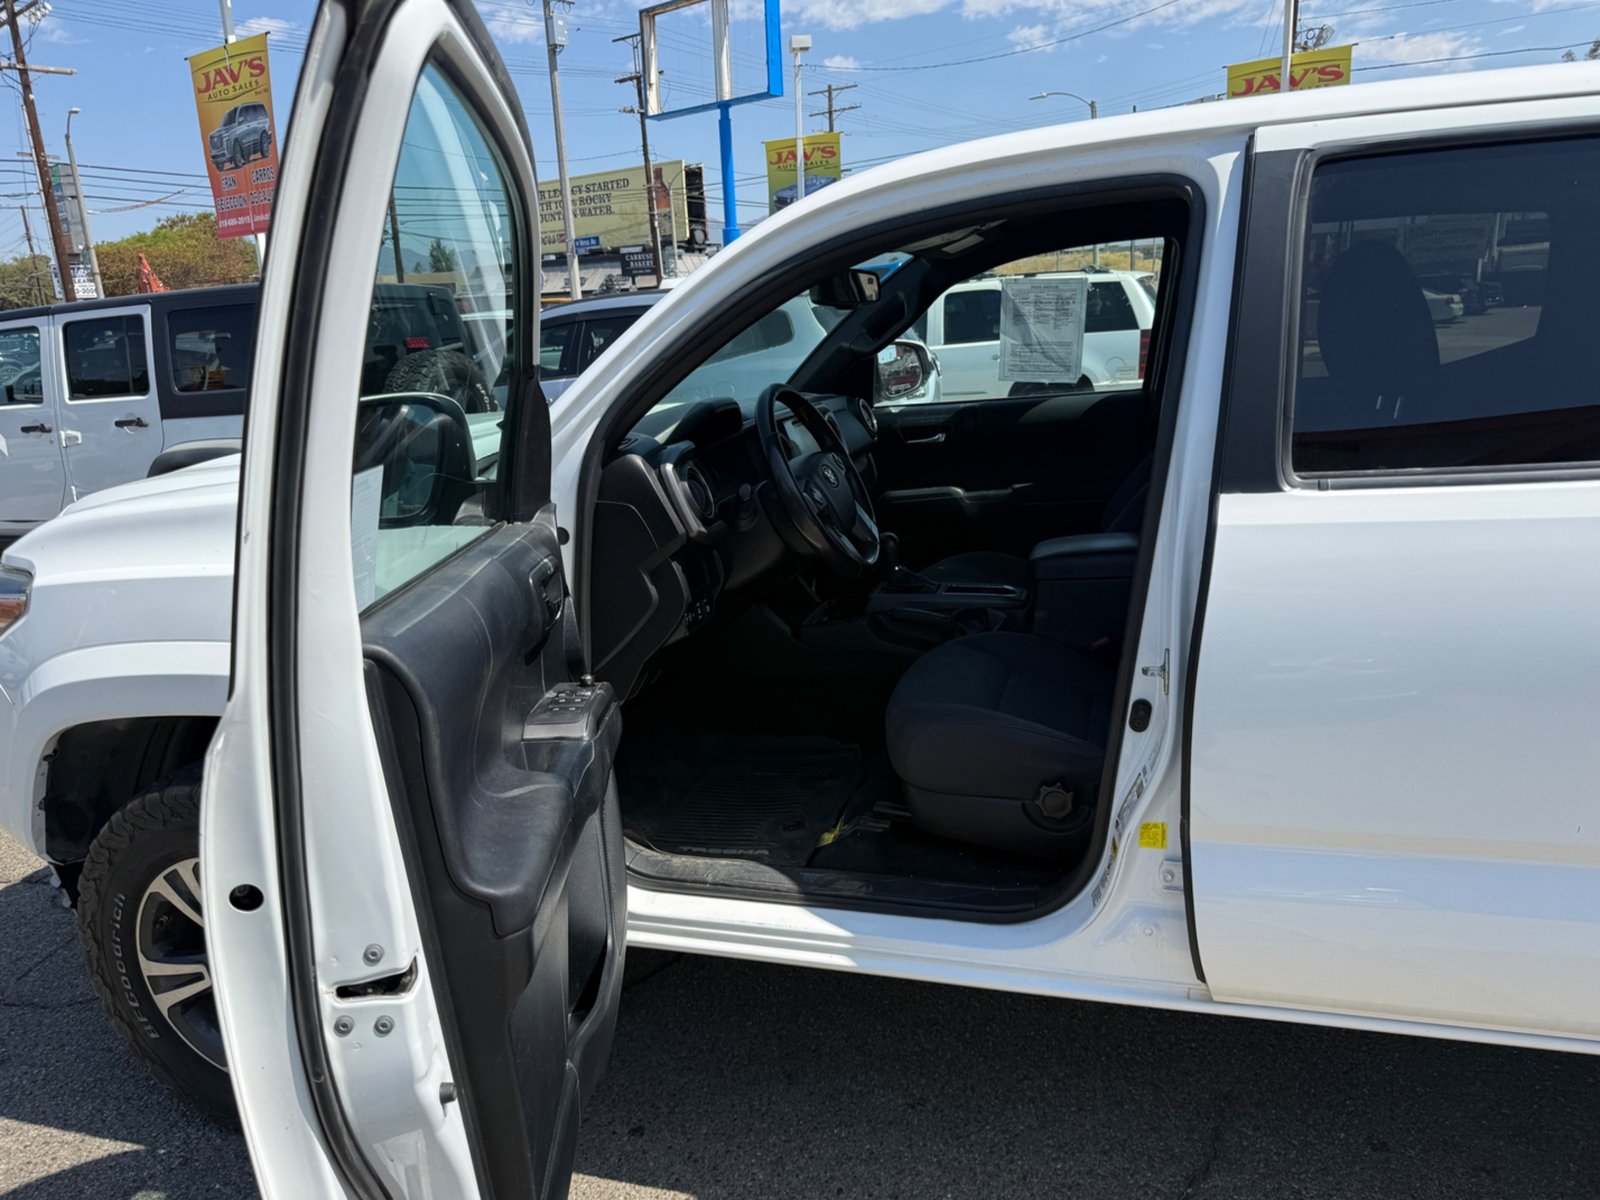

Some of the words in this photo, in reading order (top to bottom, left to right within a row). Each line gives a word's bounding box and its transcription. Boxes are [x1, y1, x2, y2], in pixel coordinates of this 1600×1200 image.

[197, 56, 265, 93] JAV'S
[1231, 63, 1344, 97] JAV'S
[208, 88, 230, 100] AUTO
[232, 80, 260, 93] SALES
[769, 145, 837, 166] JAV'S
[585, 178, 630, 194] STARTED
[579, 193, 612, 206] ROCKY
[679, 846, 769, 855] TACOMA
[111, 893, 160, 1039] BFGoodrich
